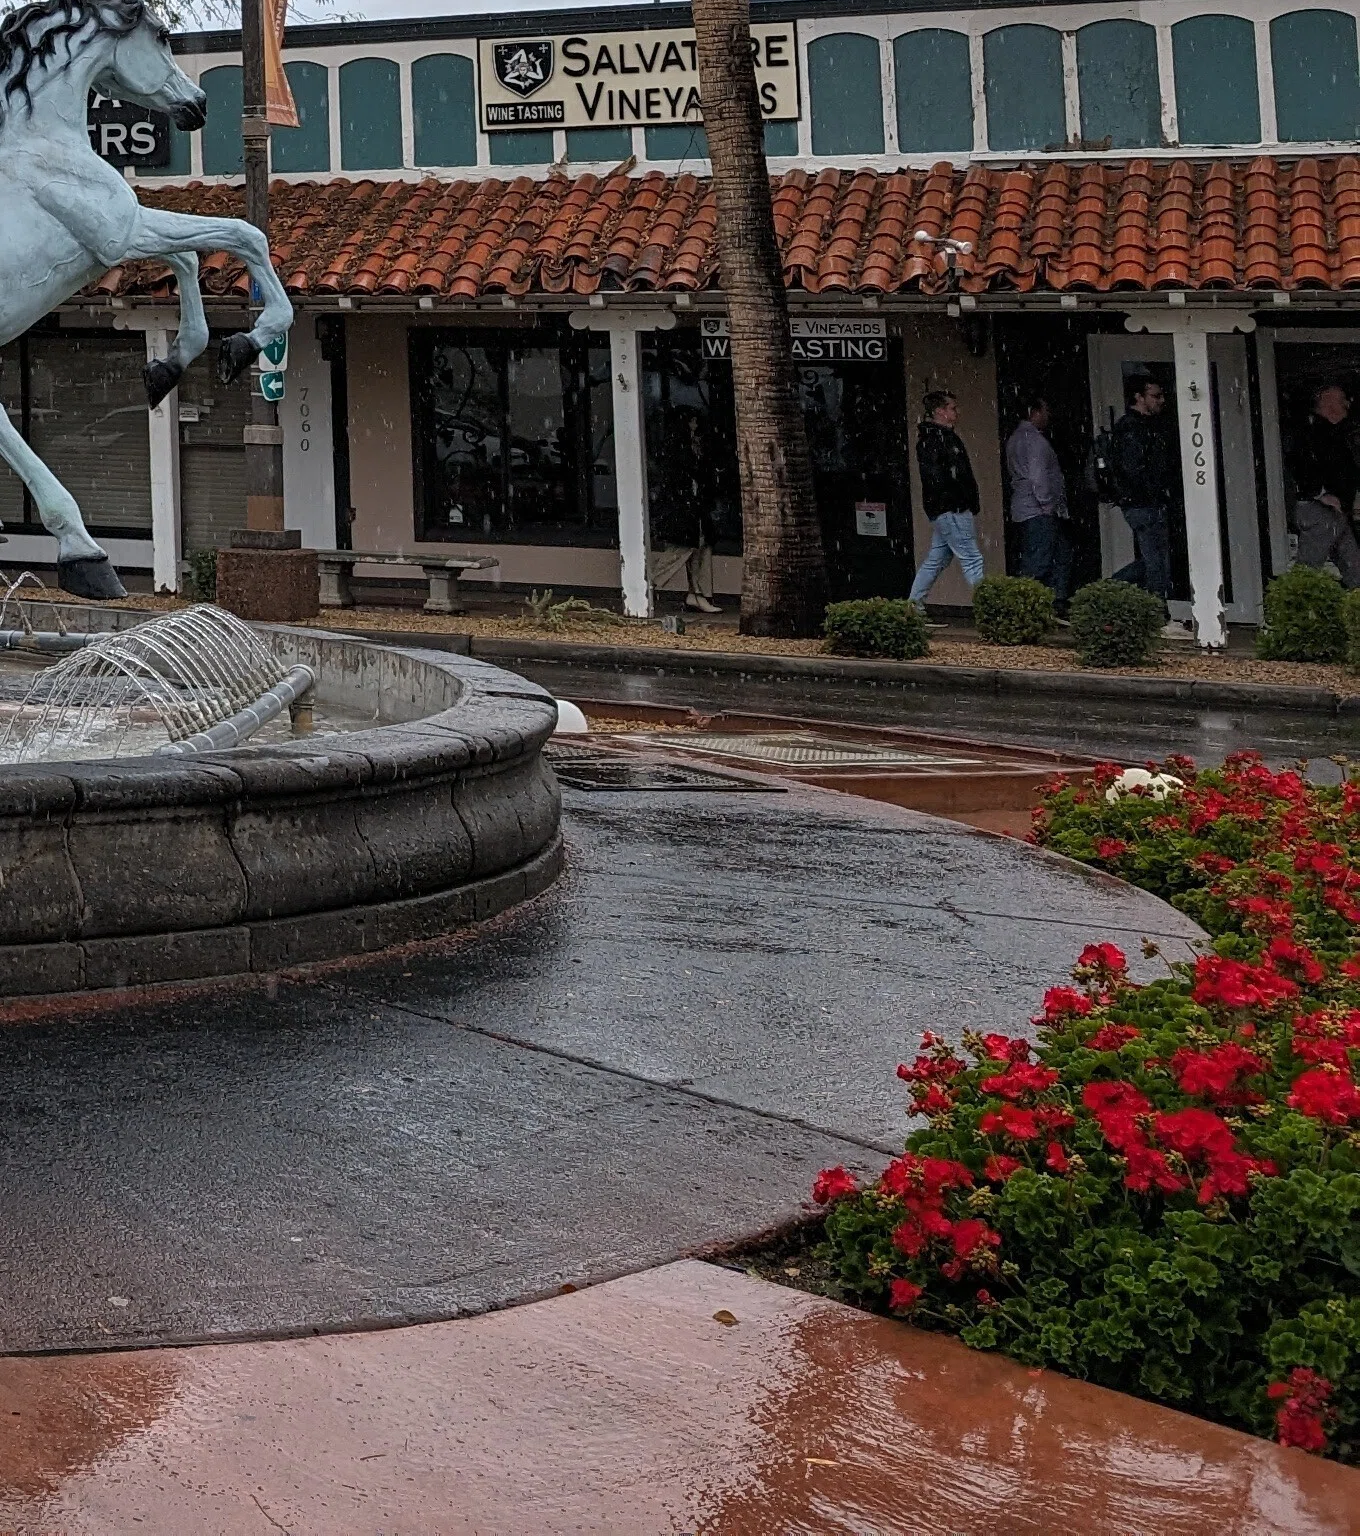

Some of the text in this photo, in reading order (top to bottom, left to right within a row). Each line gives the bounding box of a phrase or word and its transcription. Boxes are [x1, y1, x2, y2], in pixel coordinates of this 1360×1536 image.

[562, 35, 789, 77] SALVATRE
[487, 104, 563, 121] WINE TASTING
[576, 81, 777, 121] VINEYAS
[805, 321, 881, 334] VINEYARDS
[791, 339, 884, 359] ASTING
[299, 387, 311, 452] 7060
[1190, 413, 1206, 486] 7068
